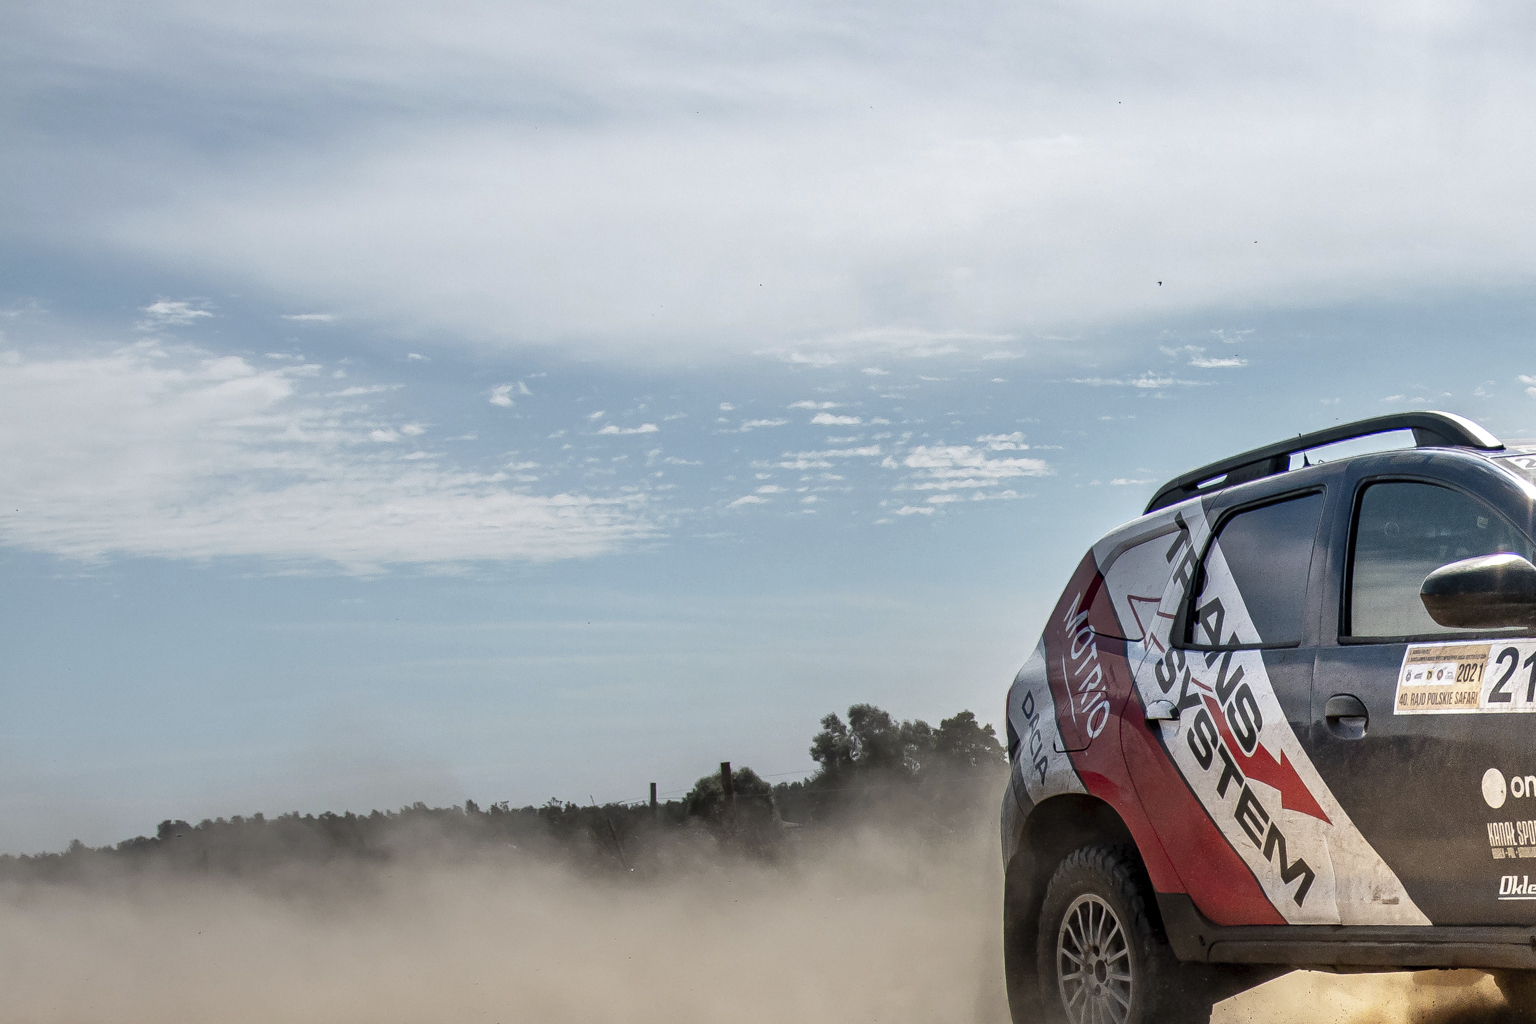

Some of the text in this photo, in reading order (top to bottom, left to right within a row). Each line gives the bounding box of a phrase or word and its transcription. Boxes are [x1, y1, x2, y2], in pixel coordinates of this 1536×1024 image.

[1410, 692, 1426, 706] RAJD
[1427, 691, 1454, 705] POLSKIE
[1454, 691, 1478, 705] SAFARI
[1456, 662, 1484, 683] 2021
[1021, 689, 1048, 786] DACIA
[1154, 647, 1316, 908] SYSTEM
